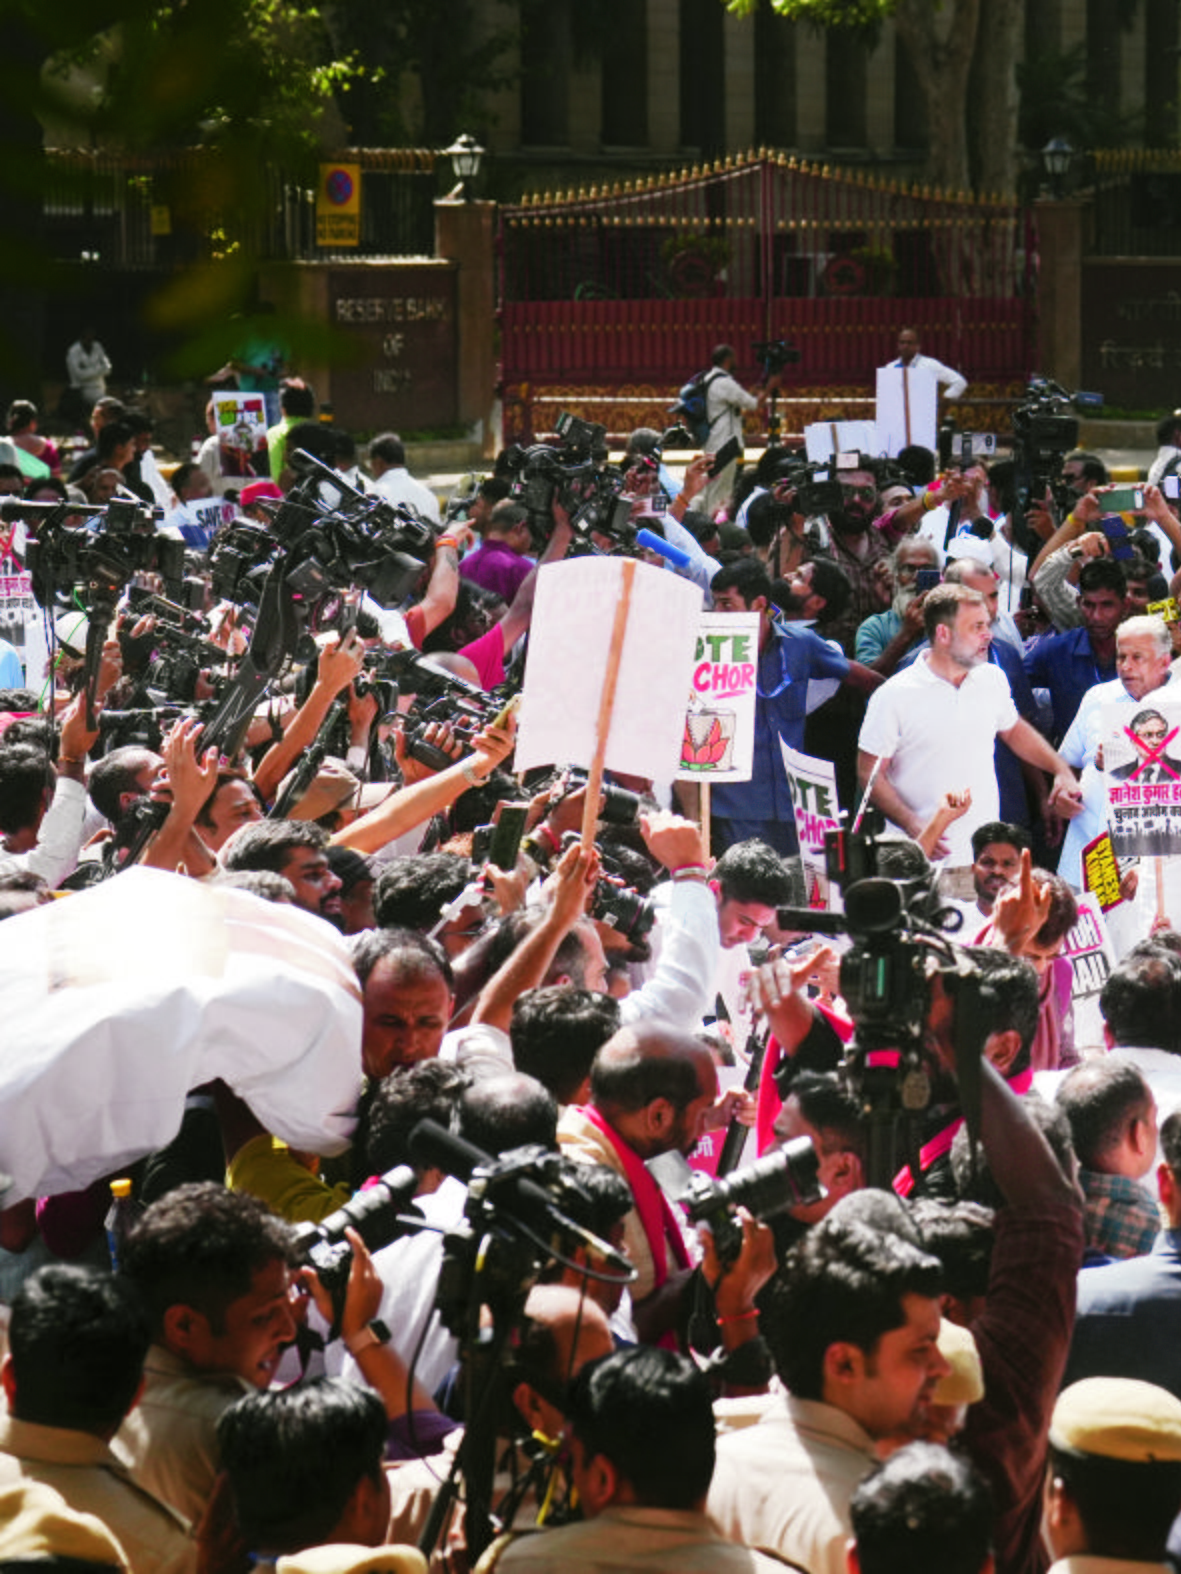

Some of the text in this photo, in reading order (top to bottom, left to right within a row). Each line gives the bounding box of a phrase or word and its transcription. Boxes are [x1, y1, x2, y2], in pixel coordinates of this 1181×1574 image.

[196, 505, 222, 528] SAVE
[693, 662, 756, 692] CHOR
[1108, 781, 1140, 804] ज्ञानेश
[1142, 784, 1169, 804] कुमार
[1113, 807, 1139, 823] चुनाव
[1141, 804, 1168, 818] आयोग
